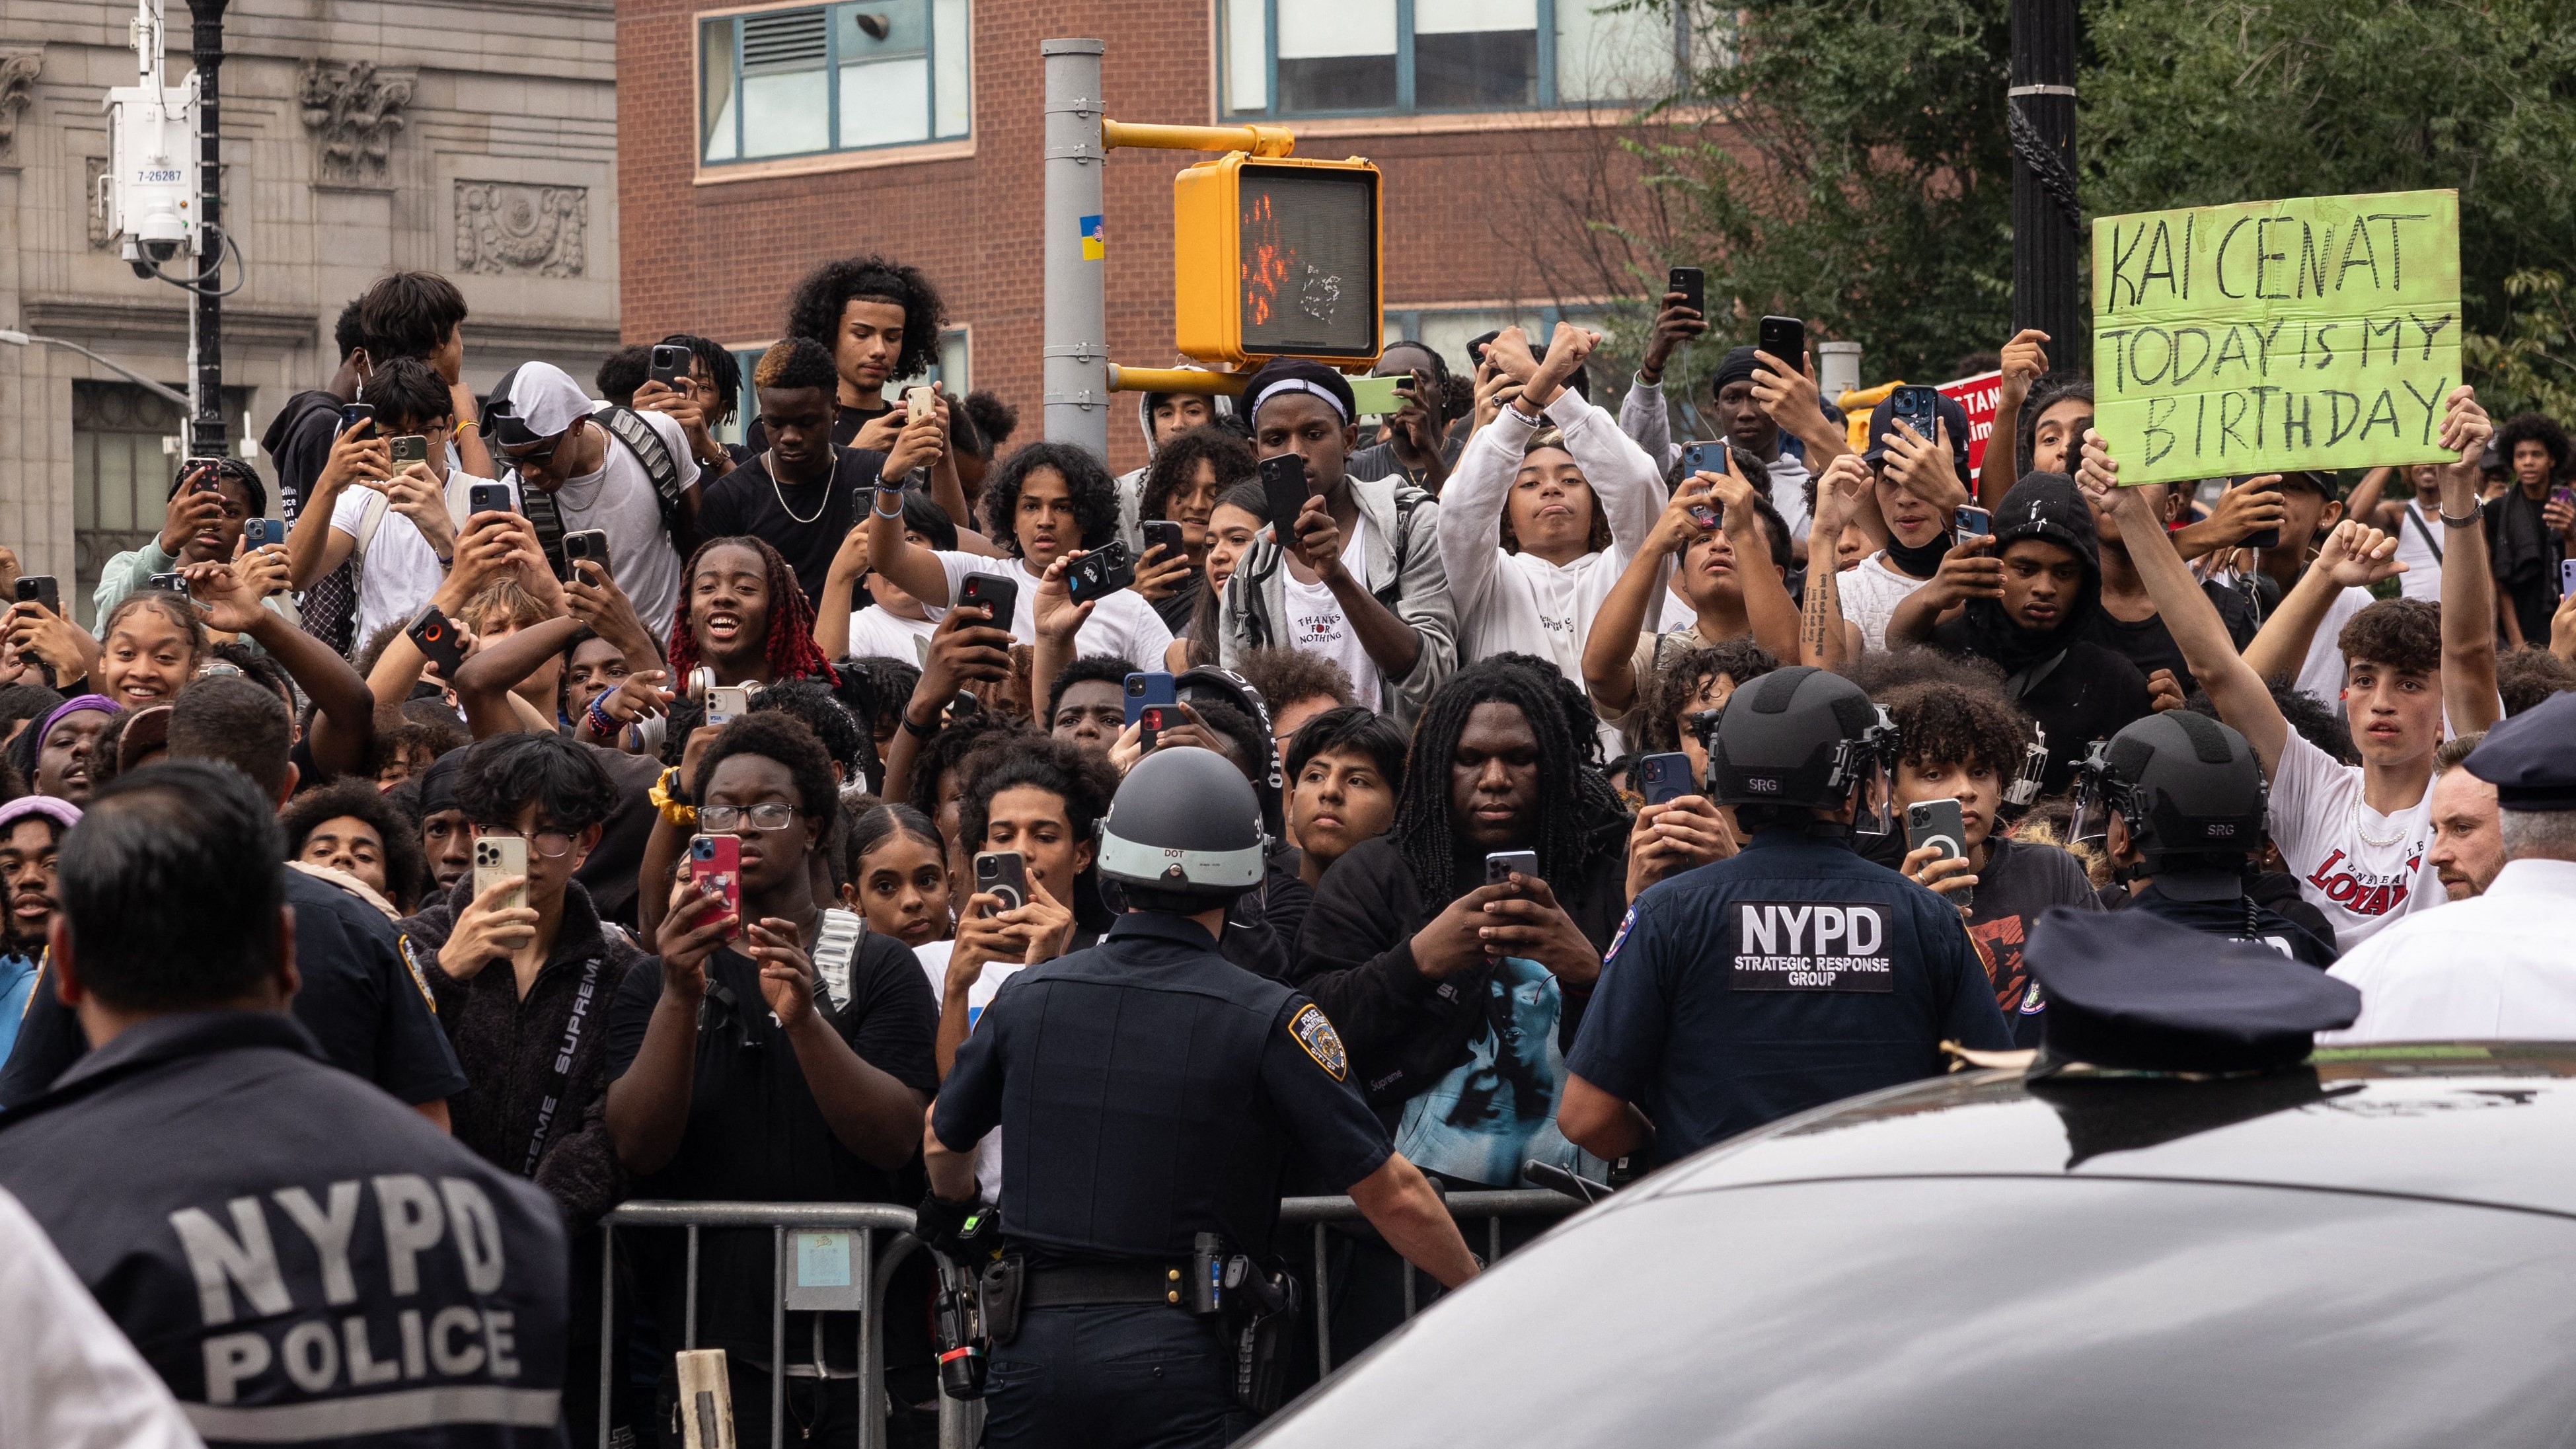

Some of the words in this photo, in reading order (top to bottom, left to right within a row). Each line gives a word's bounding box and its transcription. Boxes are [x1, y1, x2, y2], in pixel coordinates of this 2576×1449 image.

[137, 170, 181, 182] 7-26287
[2107, 212, 2194, 313] KAI
[2216, 213, 2431, 299] CENAT
[2100, 317, 2284, 394] TODAY
[2299, 321, 2339, 370] IS
[2362, 311, 2452, 368] MY
[2143, 377, 2448, 468] BIRTHDAY
[1297, 613, 1341, 626] THANKS
[1299, 631, 1342, 644] NOTHING
[1749, 778, 1777, 792] SRG
[2208, 825, 2234, 836] SRG
[1164, 849, 1184, 858] DOT
[1742, 905, 1882, 955] NYPD
[1735, 956, 1811, 971] STRATEGIC
[1817, 957, 1890, 973] RESPONSE
[1788, 971, 1837, 986] GROUP
[1301, 1009, 1319, 1026] POLICE
[1370, 1070, 1404, 1092] Supreme
[170, 1173, 505, 1327] NYPD
[204, 1306, 521, 1405] POLICE
